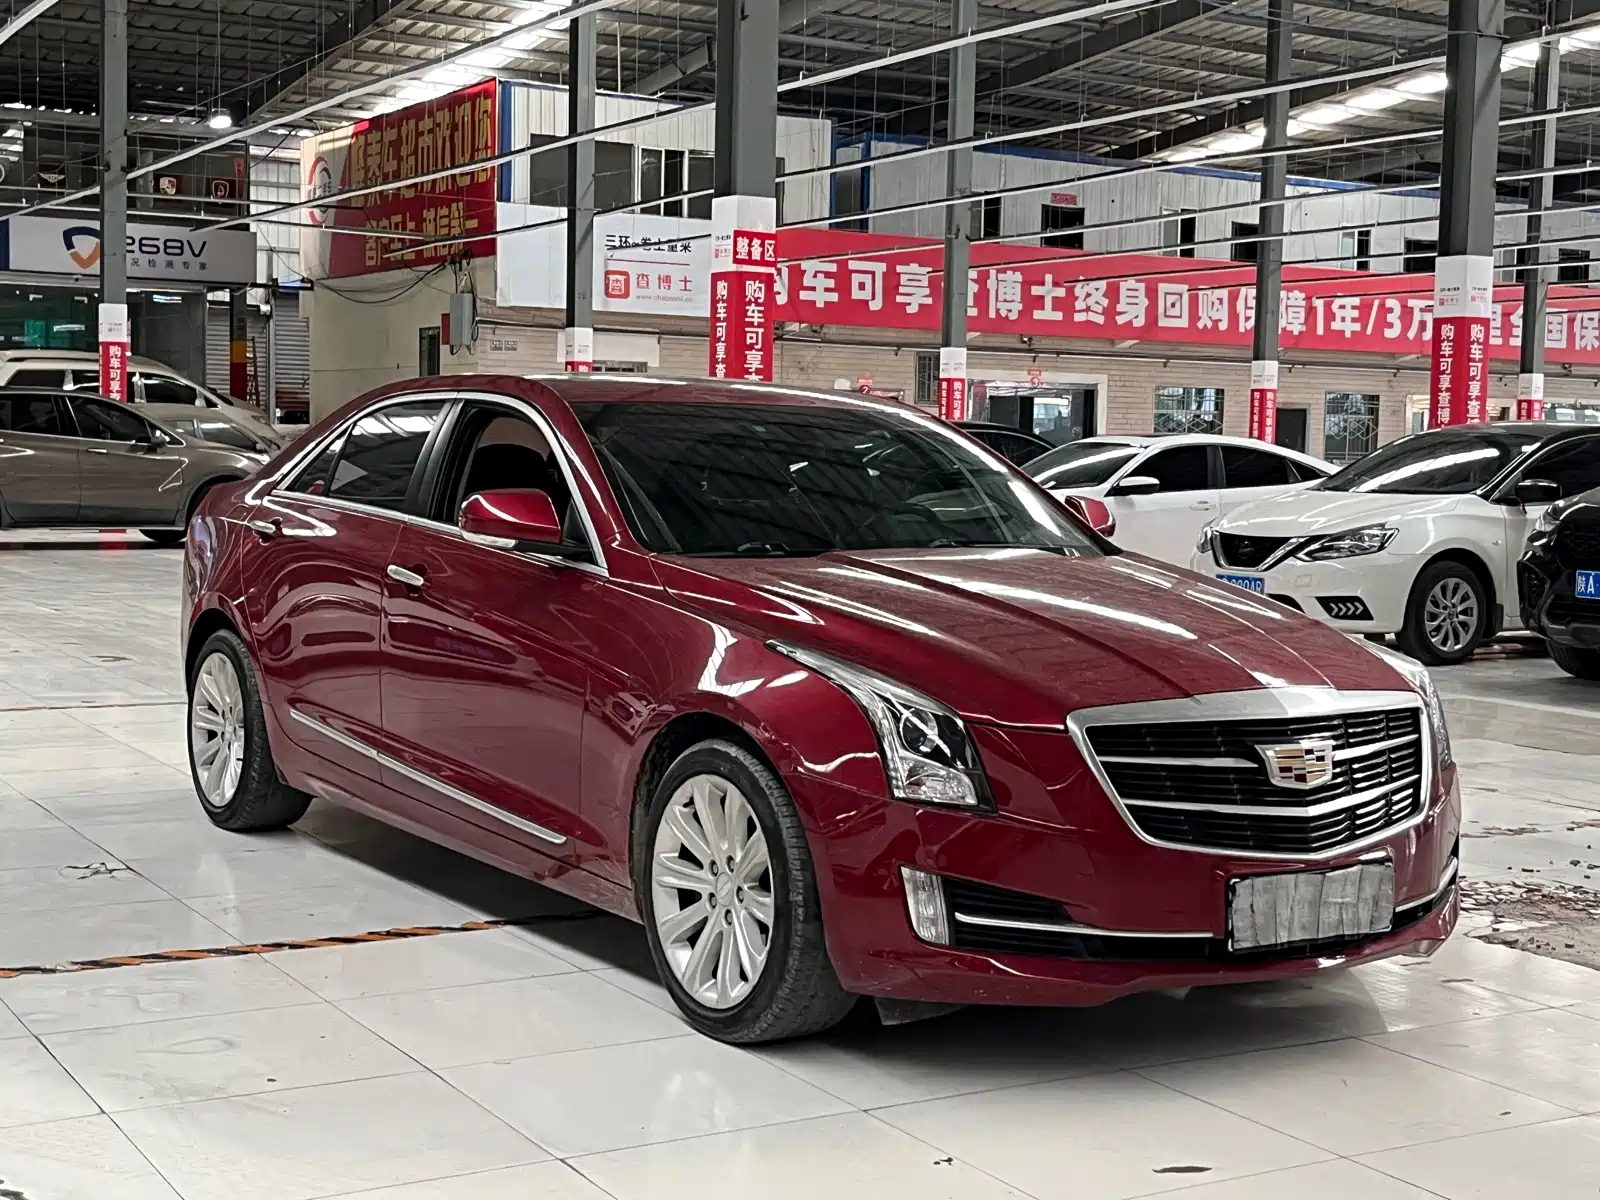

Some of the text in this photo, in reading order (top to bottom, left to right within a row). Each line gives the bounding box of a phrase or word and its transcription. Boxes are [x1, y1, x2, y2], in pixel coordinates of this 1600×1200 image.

[737, 235, 776, 262] 整备区
[635, 273, 692, 292] 查博士
[1437, 323, 1455, 428] 购车可享查博
